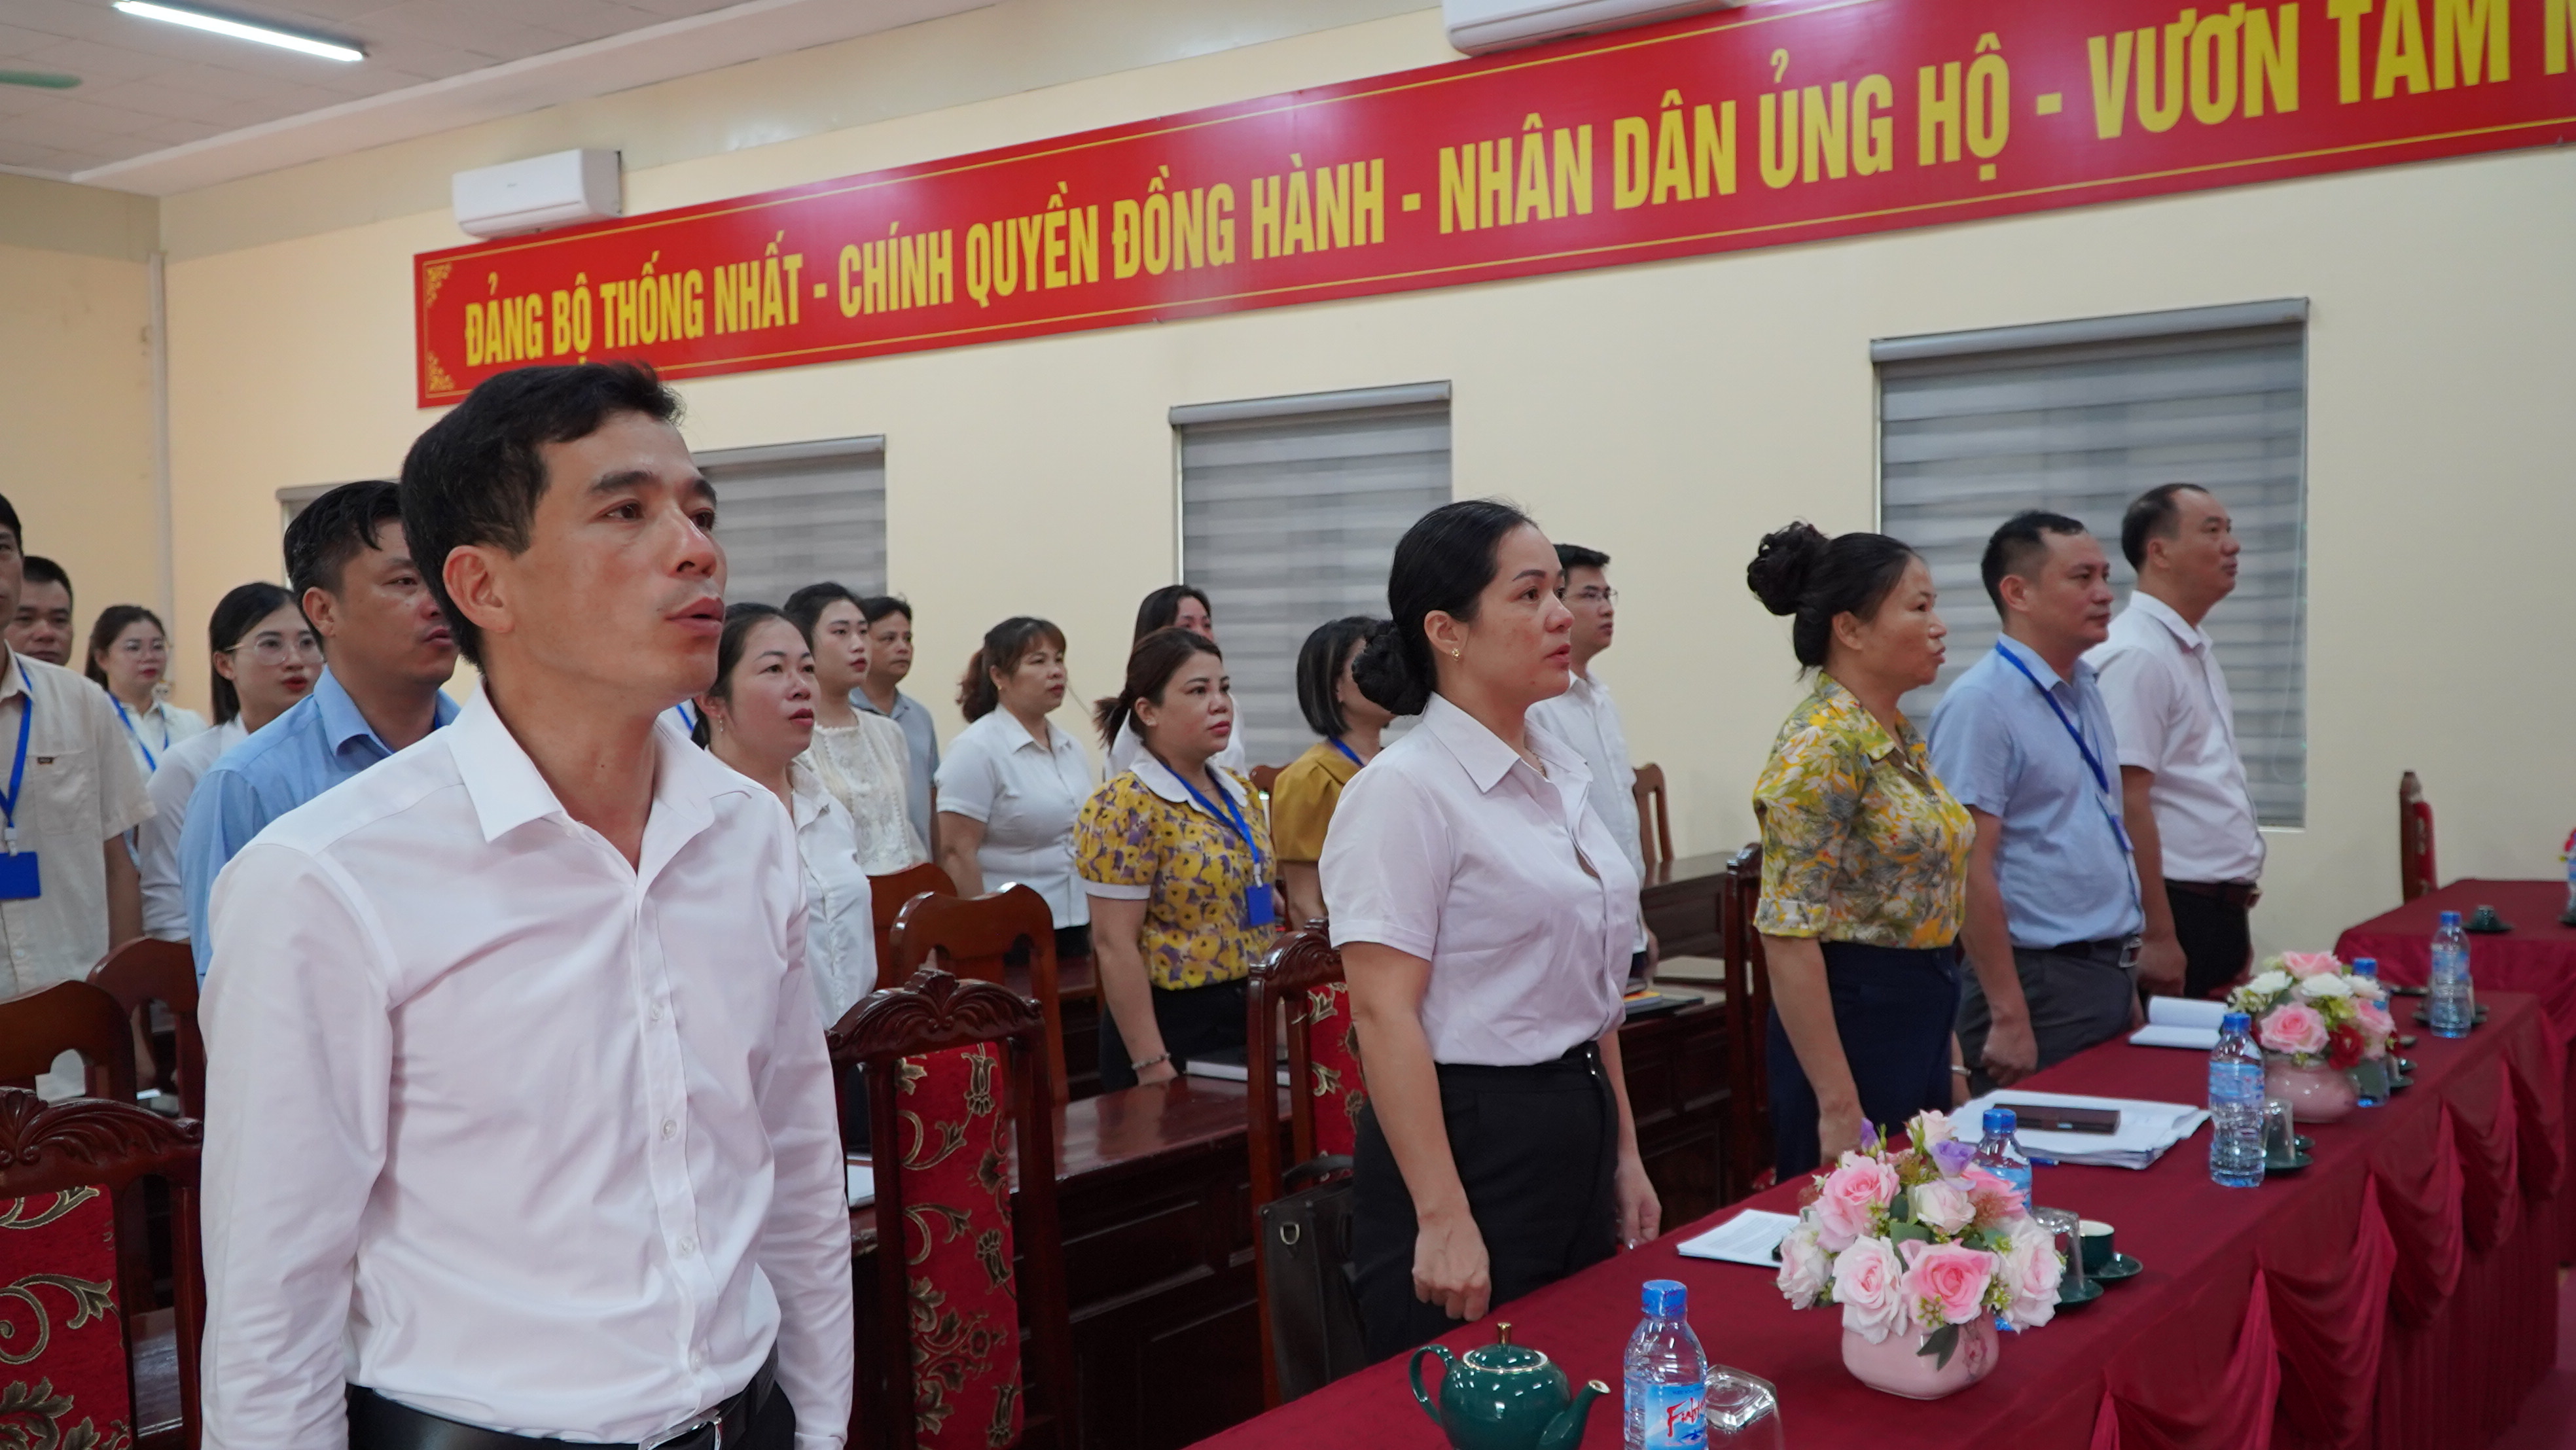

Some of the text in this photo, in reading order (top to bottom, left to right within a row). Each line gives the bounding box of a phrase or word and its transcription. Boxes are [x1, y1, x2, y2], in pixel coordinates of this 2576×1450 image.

[464, 272, 544, 367] ĐẢNG
[552, 272, 592, 365] BỘ
[599, 251, 704, 349] THỐNG
[713, 230, 804, 335] NHẤT
[813, 283, 828, 299] -
[838, 222, 954, 318] CHÍNH
[965, 181, 1100, 308] QUYỀN
[1111, 164, 1236, 279] ĐỒNG
[1251, 153, 1385, 260] HÀNH
[1402, 192, 1422, 212] -
[1439, 113, 1593, 234] NHÂN
[1613, 88, 1737, 210] DÂN
[1759, 48, 1893, 189] ỦNG
[1918, 32, 2011, 182] HỘ
[2036, 93, 2062, 116] -
[2087, 2, 2299, 139] VƯƠN
